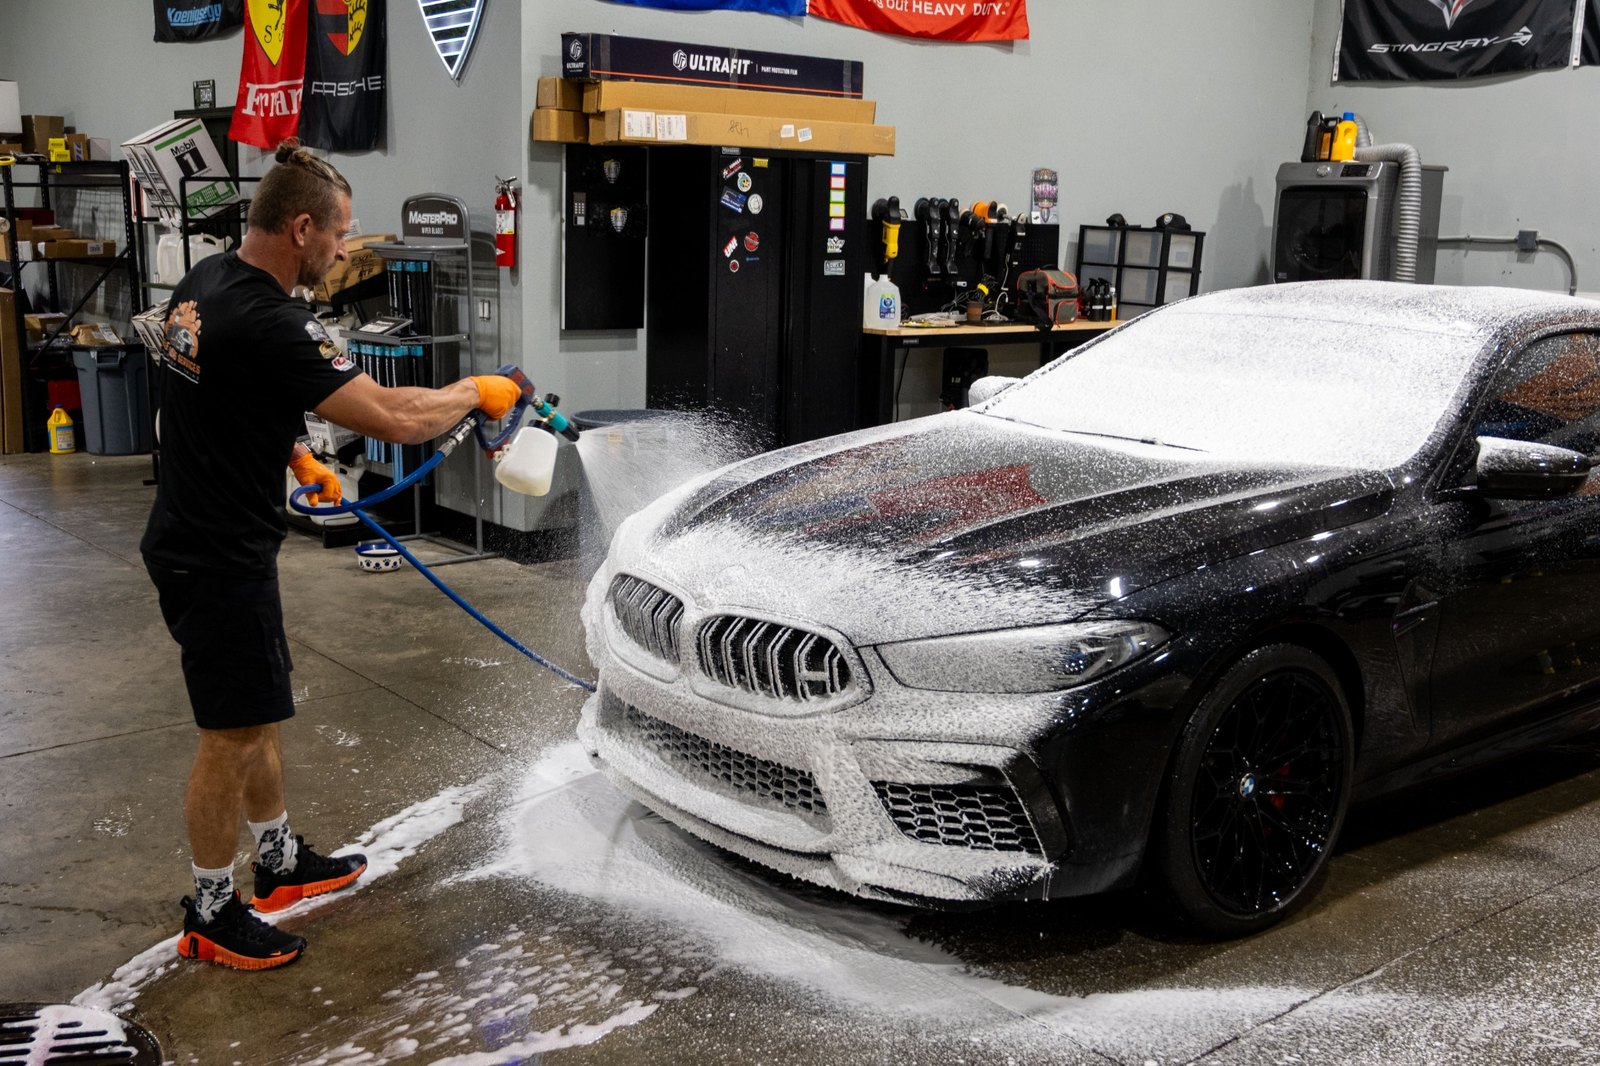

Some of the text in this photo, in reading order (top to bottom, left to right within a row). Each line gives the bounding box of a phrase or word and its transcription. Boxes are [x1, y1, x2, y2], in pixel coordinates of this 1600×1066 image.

[167, 4, 222, 23] Koenigsegg
[912, 1, 967, 16] HEAVY
[1367, 36, 1499, 53] STINGRAY
[689, 54, 750, 75] ULTRAFIT
[170, 138, 196, 156] Mobil
[182, 152, 199, 173] 1
